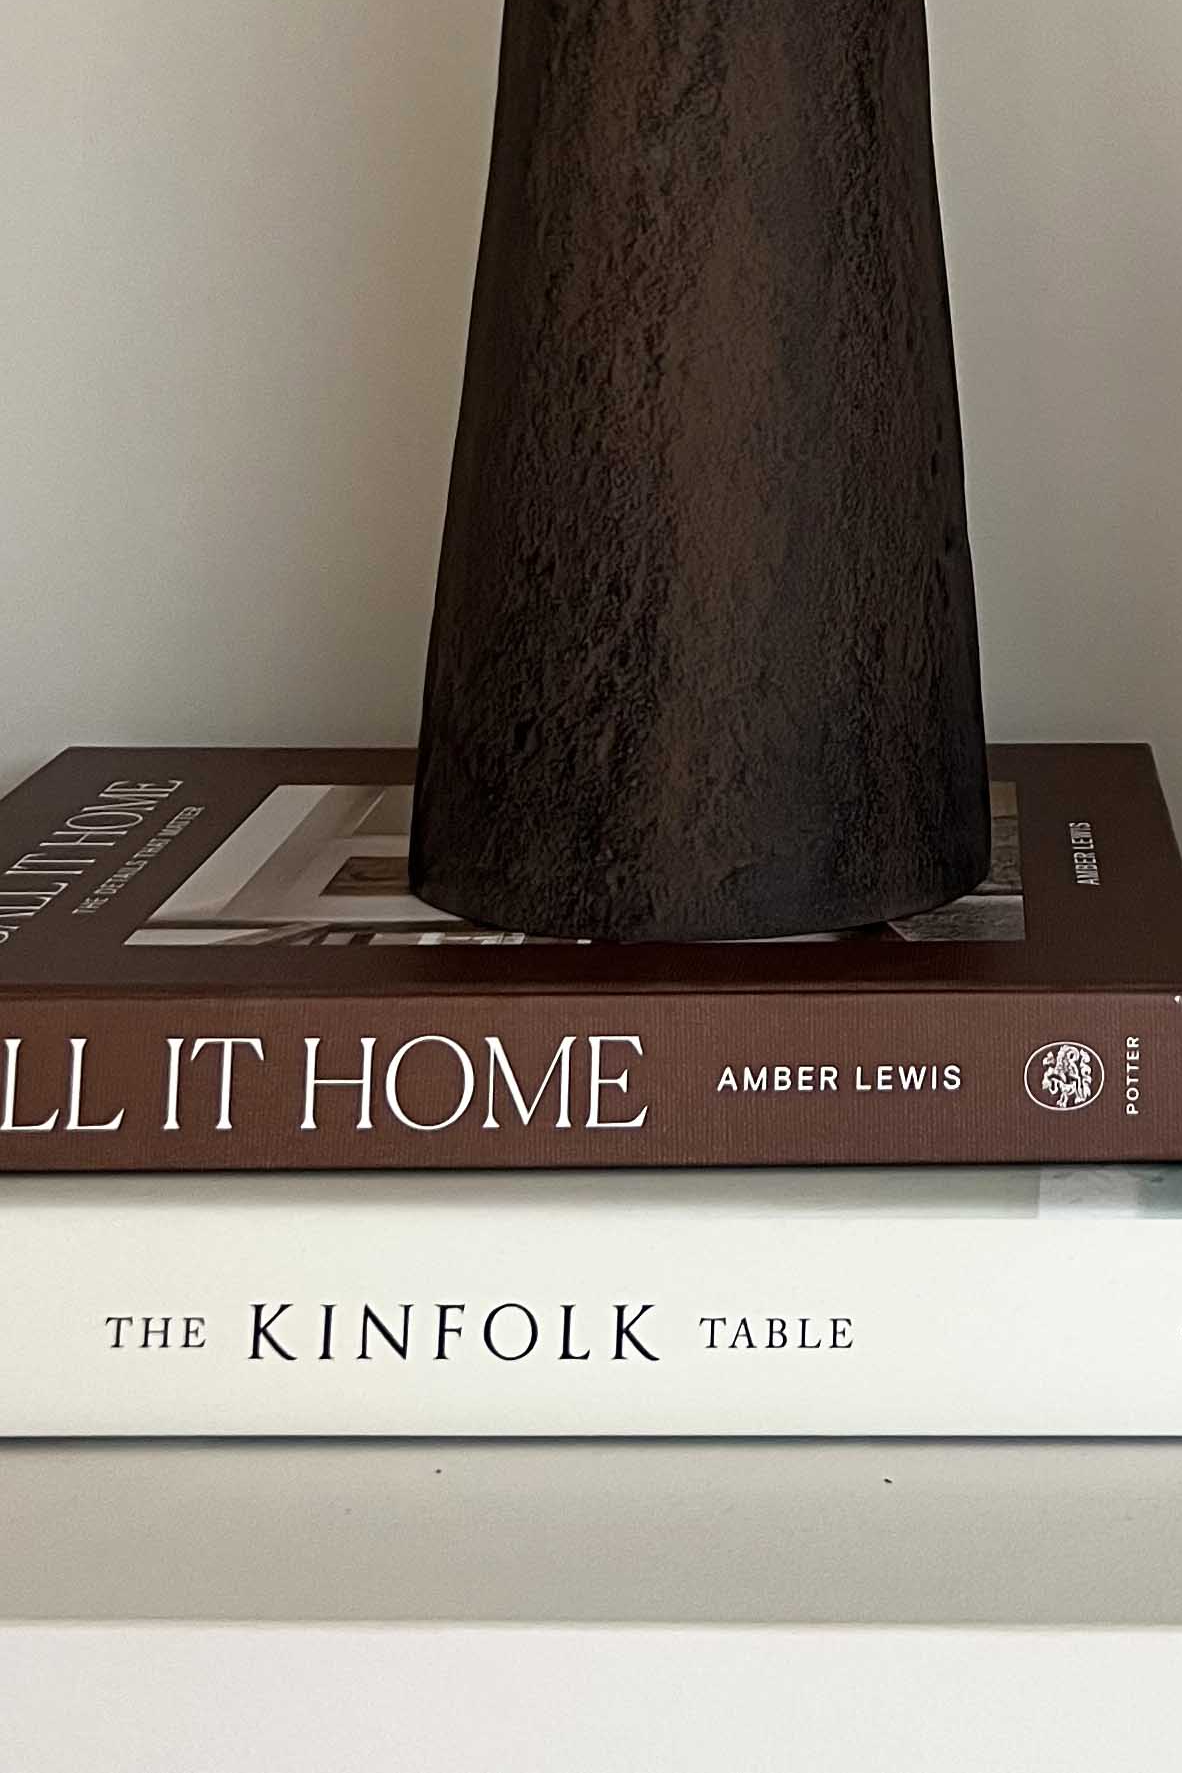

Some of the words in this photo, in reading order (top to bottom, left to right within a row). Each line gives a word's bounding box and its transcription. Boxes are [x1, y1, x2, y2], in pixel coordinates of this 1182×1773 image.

[38, 779, 184, 847] HOME
[1068, 822, 1095, 850] LEWIS
[4, 852, 96, 875] IT
[1073, 852, 1101, 884] AMBER
[164, 1037, 265, 1131] IT
[300, 1035, 648, 1131] HOME
[716, 1066, 838, 1092] AMBER
[855, 1064, 962, 1091] LEWIS
[1126, 1036, 1140, 1115] POTTER
[105, 1316, 207, 1349] THE
[247, 1303, 660, 1362] KINFOLK
[699, 1317, 854, 1349] TABLE
